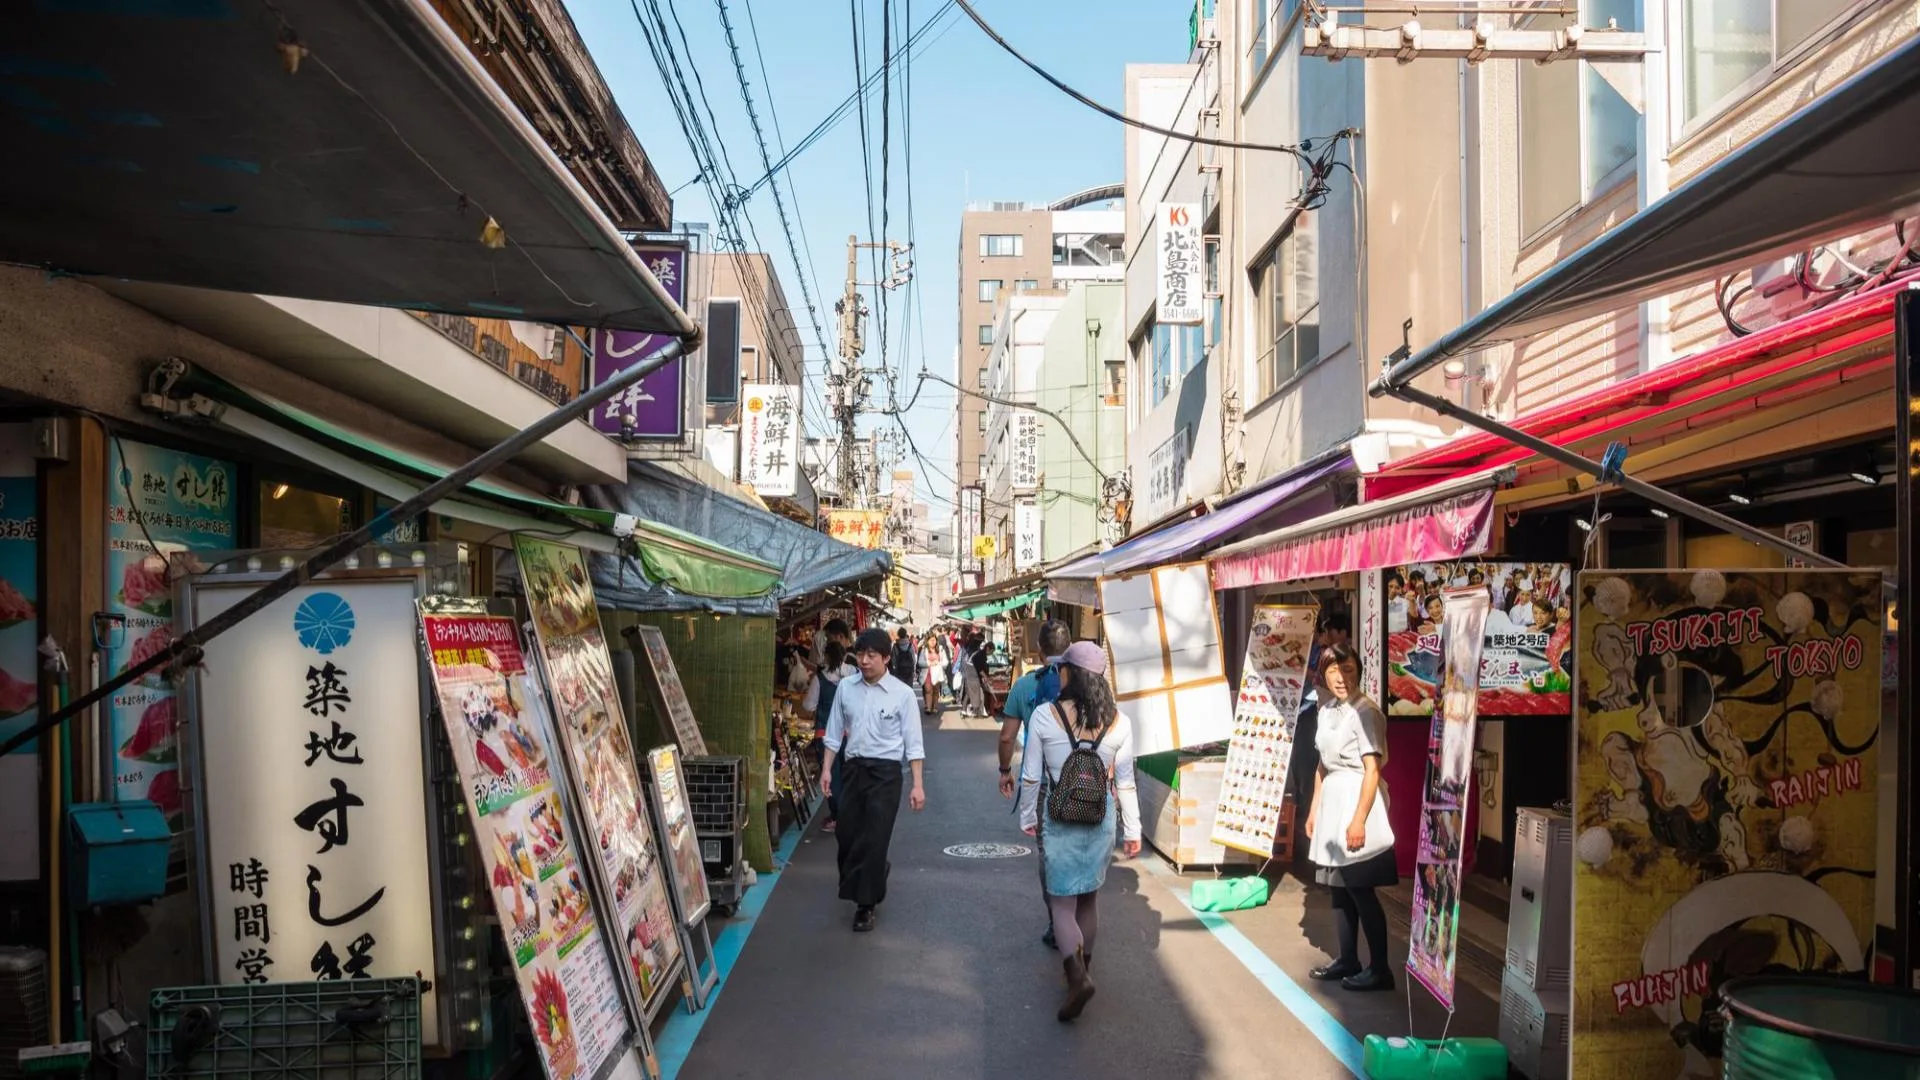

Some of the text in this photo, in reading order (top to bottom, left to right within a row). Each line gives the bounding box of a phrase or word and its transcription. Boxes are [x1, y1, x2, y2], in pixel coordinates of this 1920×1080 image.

[1164, 231, 1189, 307] 北島商店
[1189, 227, 1200, 274] 株式会社
[763, 395, 792, 477] 海鮮丼
[142, 472, 167, 494] 築地
[832, 519, 881, 536] 海鮮丼
[1493, 634, 1548, 647] 築地2号店
[1627, 606, 1766, 657] TSUKIJI
[1766, 634, 1864, 681] TOKYO
[1769, 757, 1862, 809] RAIJIN
[1611, 960, 1710, 1015] FUHJIN
